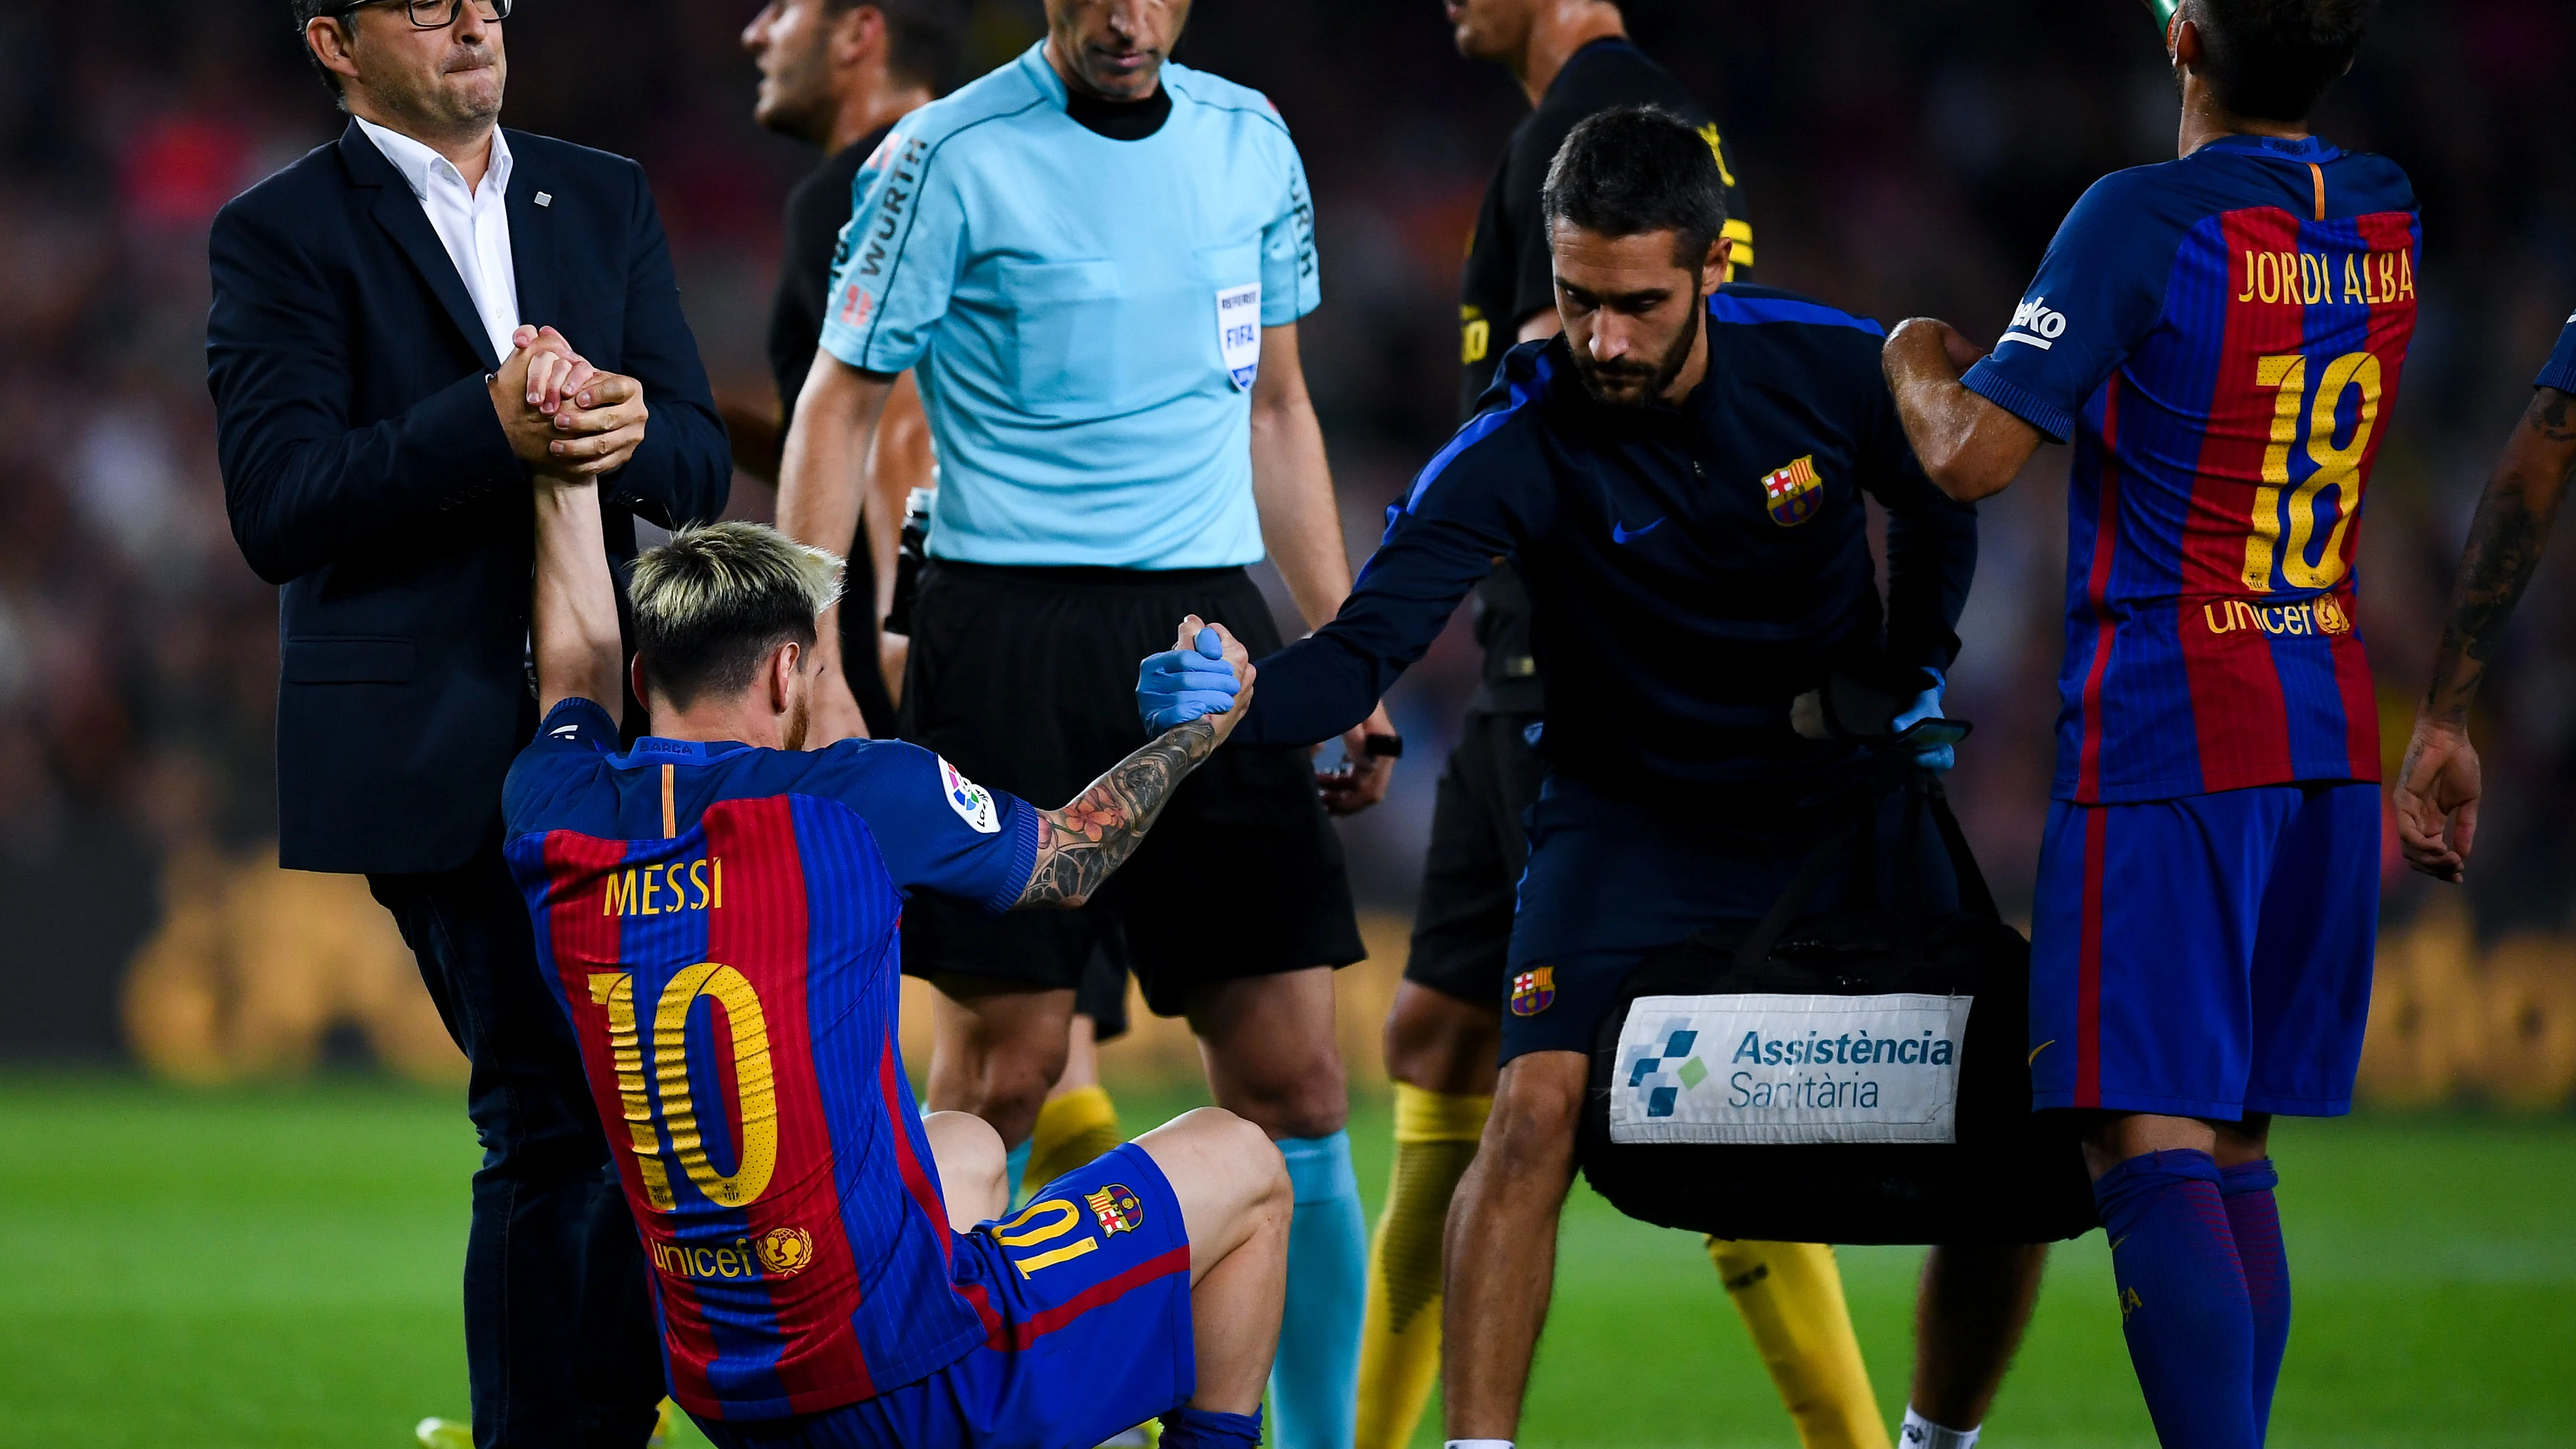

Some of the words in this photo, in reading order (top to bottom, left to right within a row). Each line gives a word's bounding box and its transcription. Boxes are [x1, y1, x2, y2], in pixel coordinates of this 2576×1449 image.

[2238, 250, 2333, 305] JORDI
[2344, 248, 2415, 304] ALBA
[1226, 323, 1254, 349] FIFA
[2241, 352, 2381, 593] 18
[2204, 599, 2312, 635] unicef
[603, 856, 721, 916] MESSI
[1732, 1029, 1954, 1065] Assistència
[587, 962, 777, 1211] 10
[1728, 1071, 1878, 1108] Sanitària
[650, 1238, 752, 1277] unicef
[991, 1199, 1099, 1280] 10
